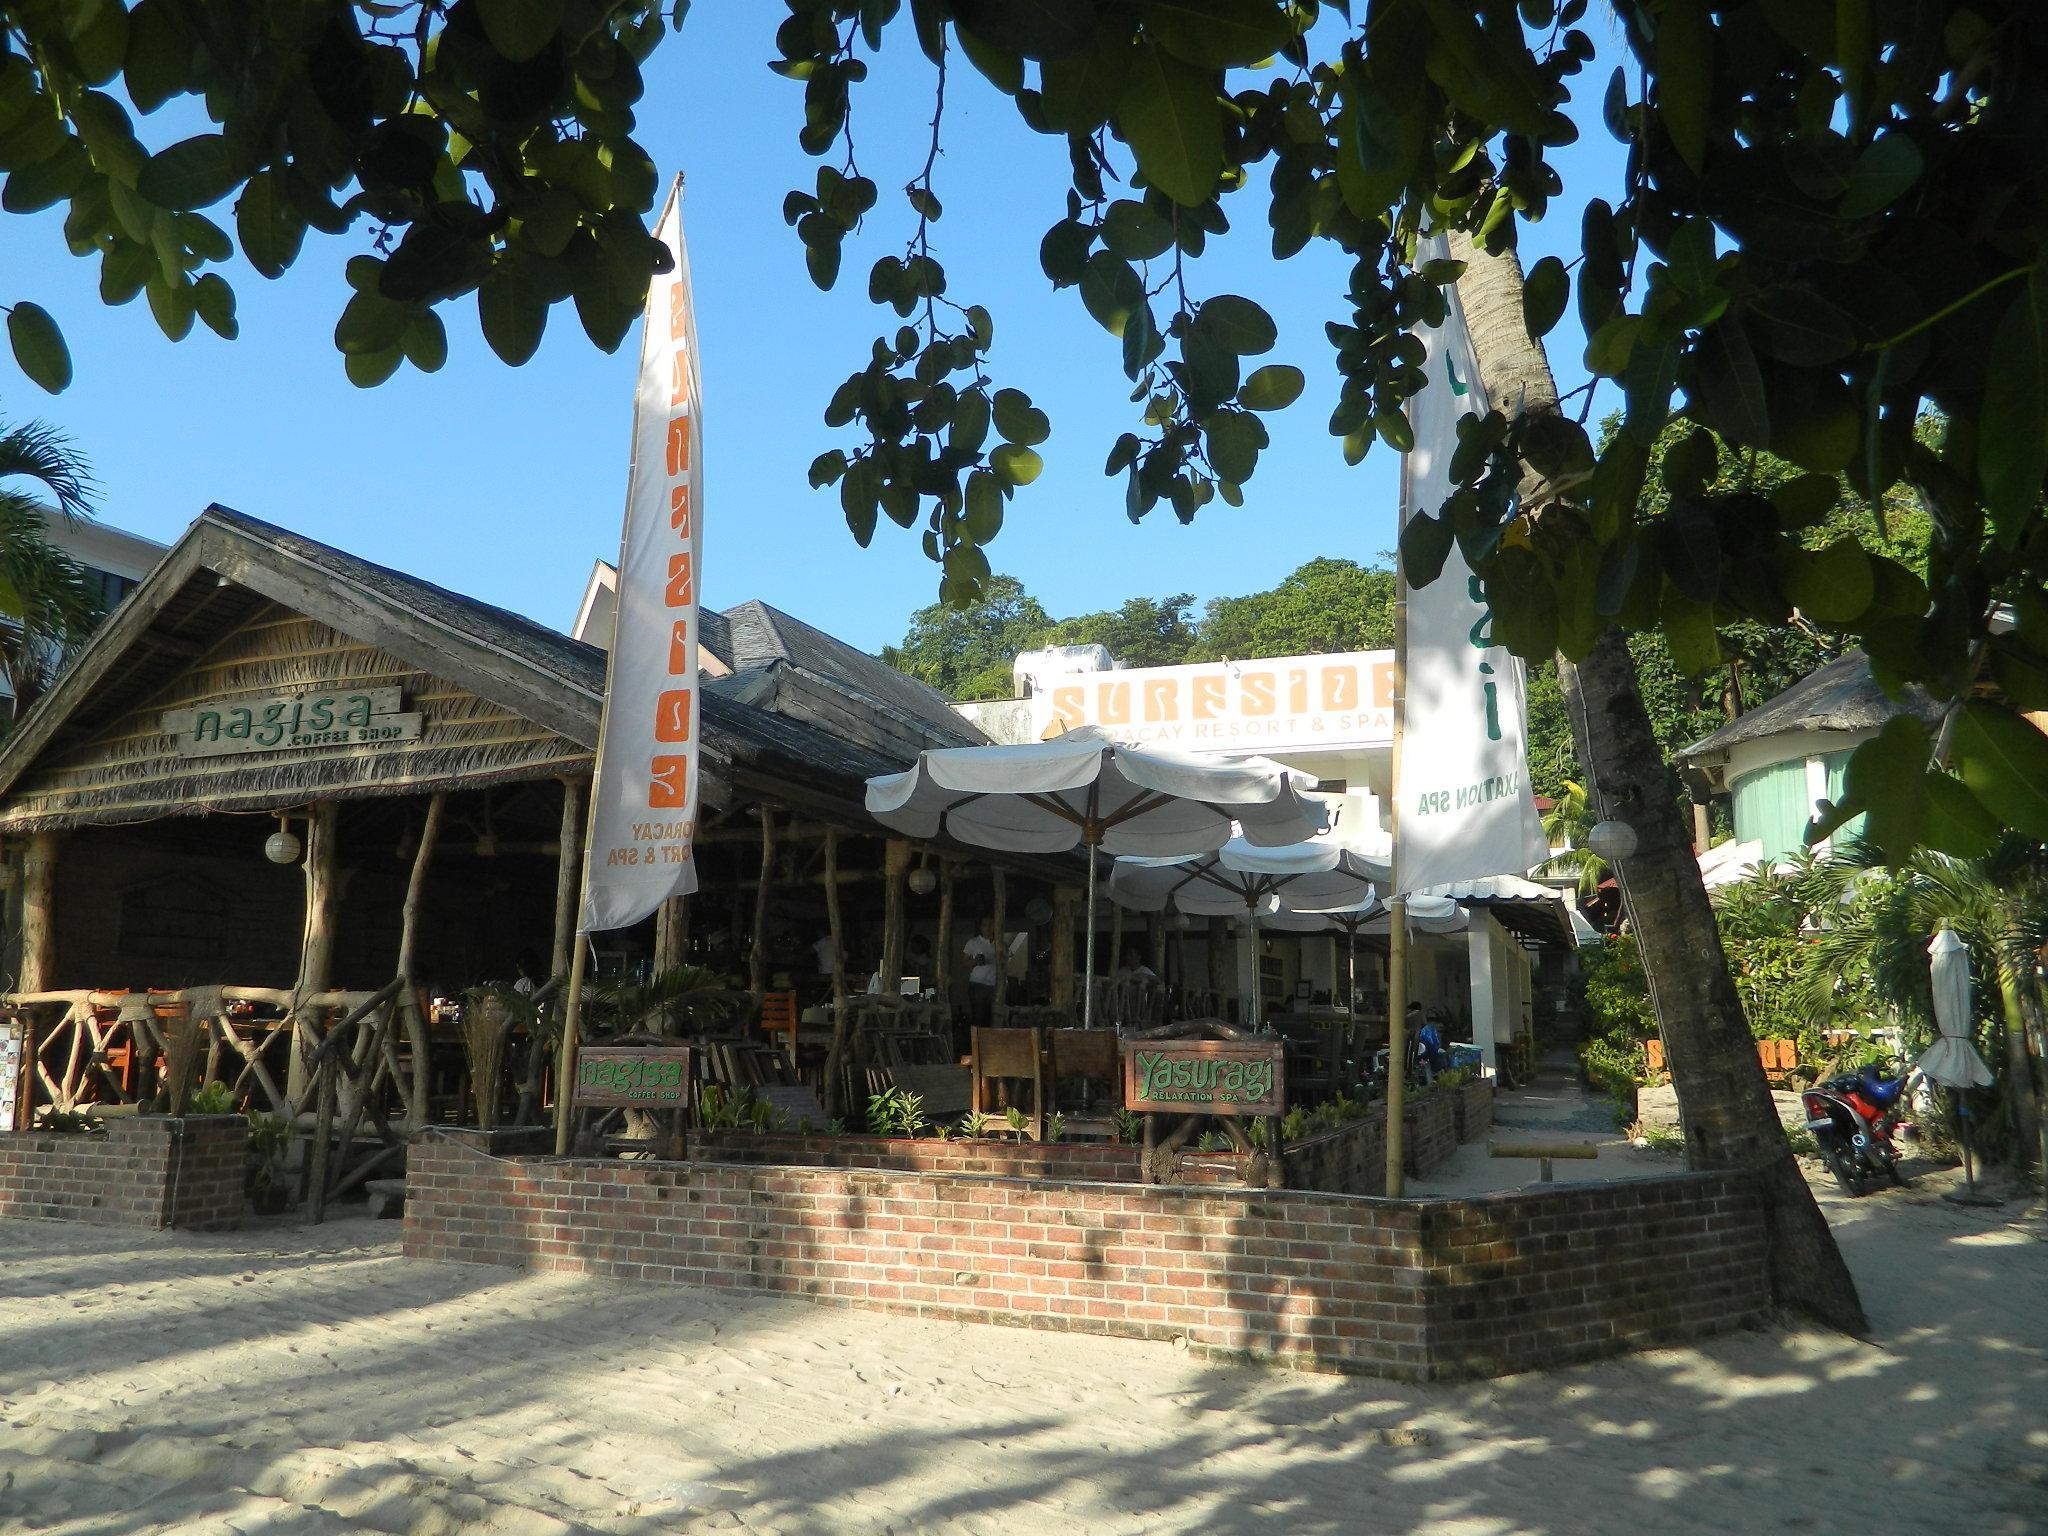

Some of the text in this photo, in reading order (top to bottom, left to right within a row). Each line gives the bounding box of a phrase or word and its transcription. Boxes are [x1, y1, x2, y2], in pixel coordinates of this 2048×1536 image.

[194, 692, 371, 746] nagisa
[1110, 713, 1388, 742] RACAY RESORT & SPA
[291, 726, 402, 746] COFFEE SHOP
[580, 1057, 682, 1093] nagisa
[1136, 1051, 1273, 1101] Yasuragi
[628, 1091, 681, 1099] COFFEE SHOP
[1152, 1091, 1239, 1102] RELAXATION SPA
